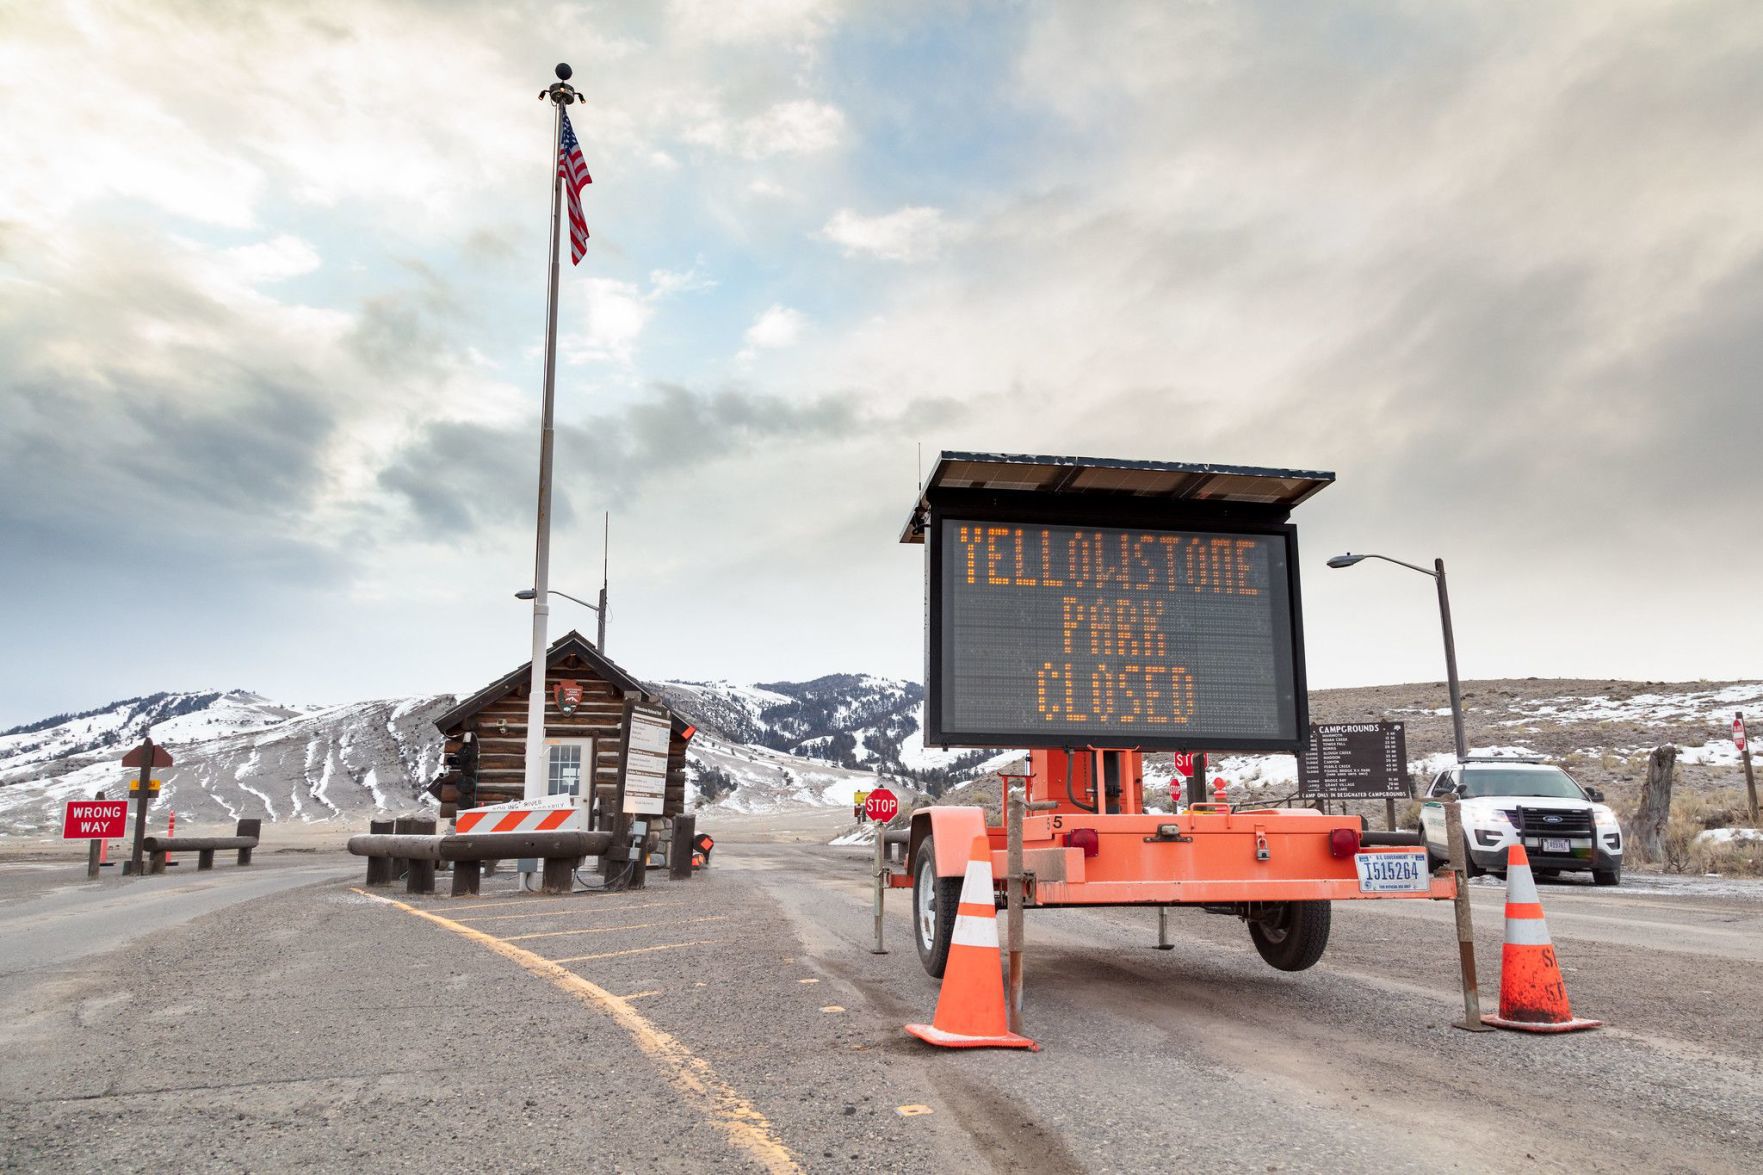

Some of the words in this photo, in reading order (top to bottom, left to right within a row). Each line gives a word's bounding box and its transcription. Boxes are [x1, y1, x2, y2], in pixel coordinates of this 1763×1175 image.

[961, 527, 1258, 596] YELLOWSTONE
[1063, 597, 1166, 656] PARK
[1037, 662, 1194, 724] CLOSED
[1319, 724, 1380, 734] CAMPGROUNDS
[73, 806, 121, 819] WRONG
[867, 799, 897, 812] STOP
[80, 821, 111, 833] WAY
[1053, 815, 1063, 829] 5
[1364, 861, 1419, 880] I515264
